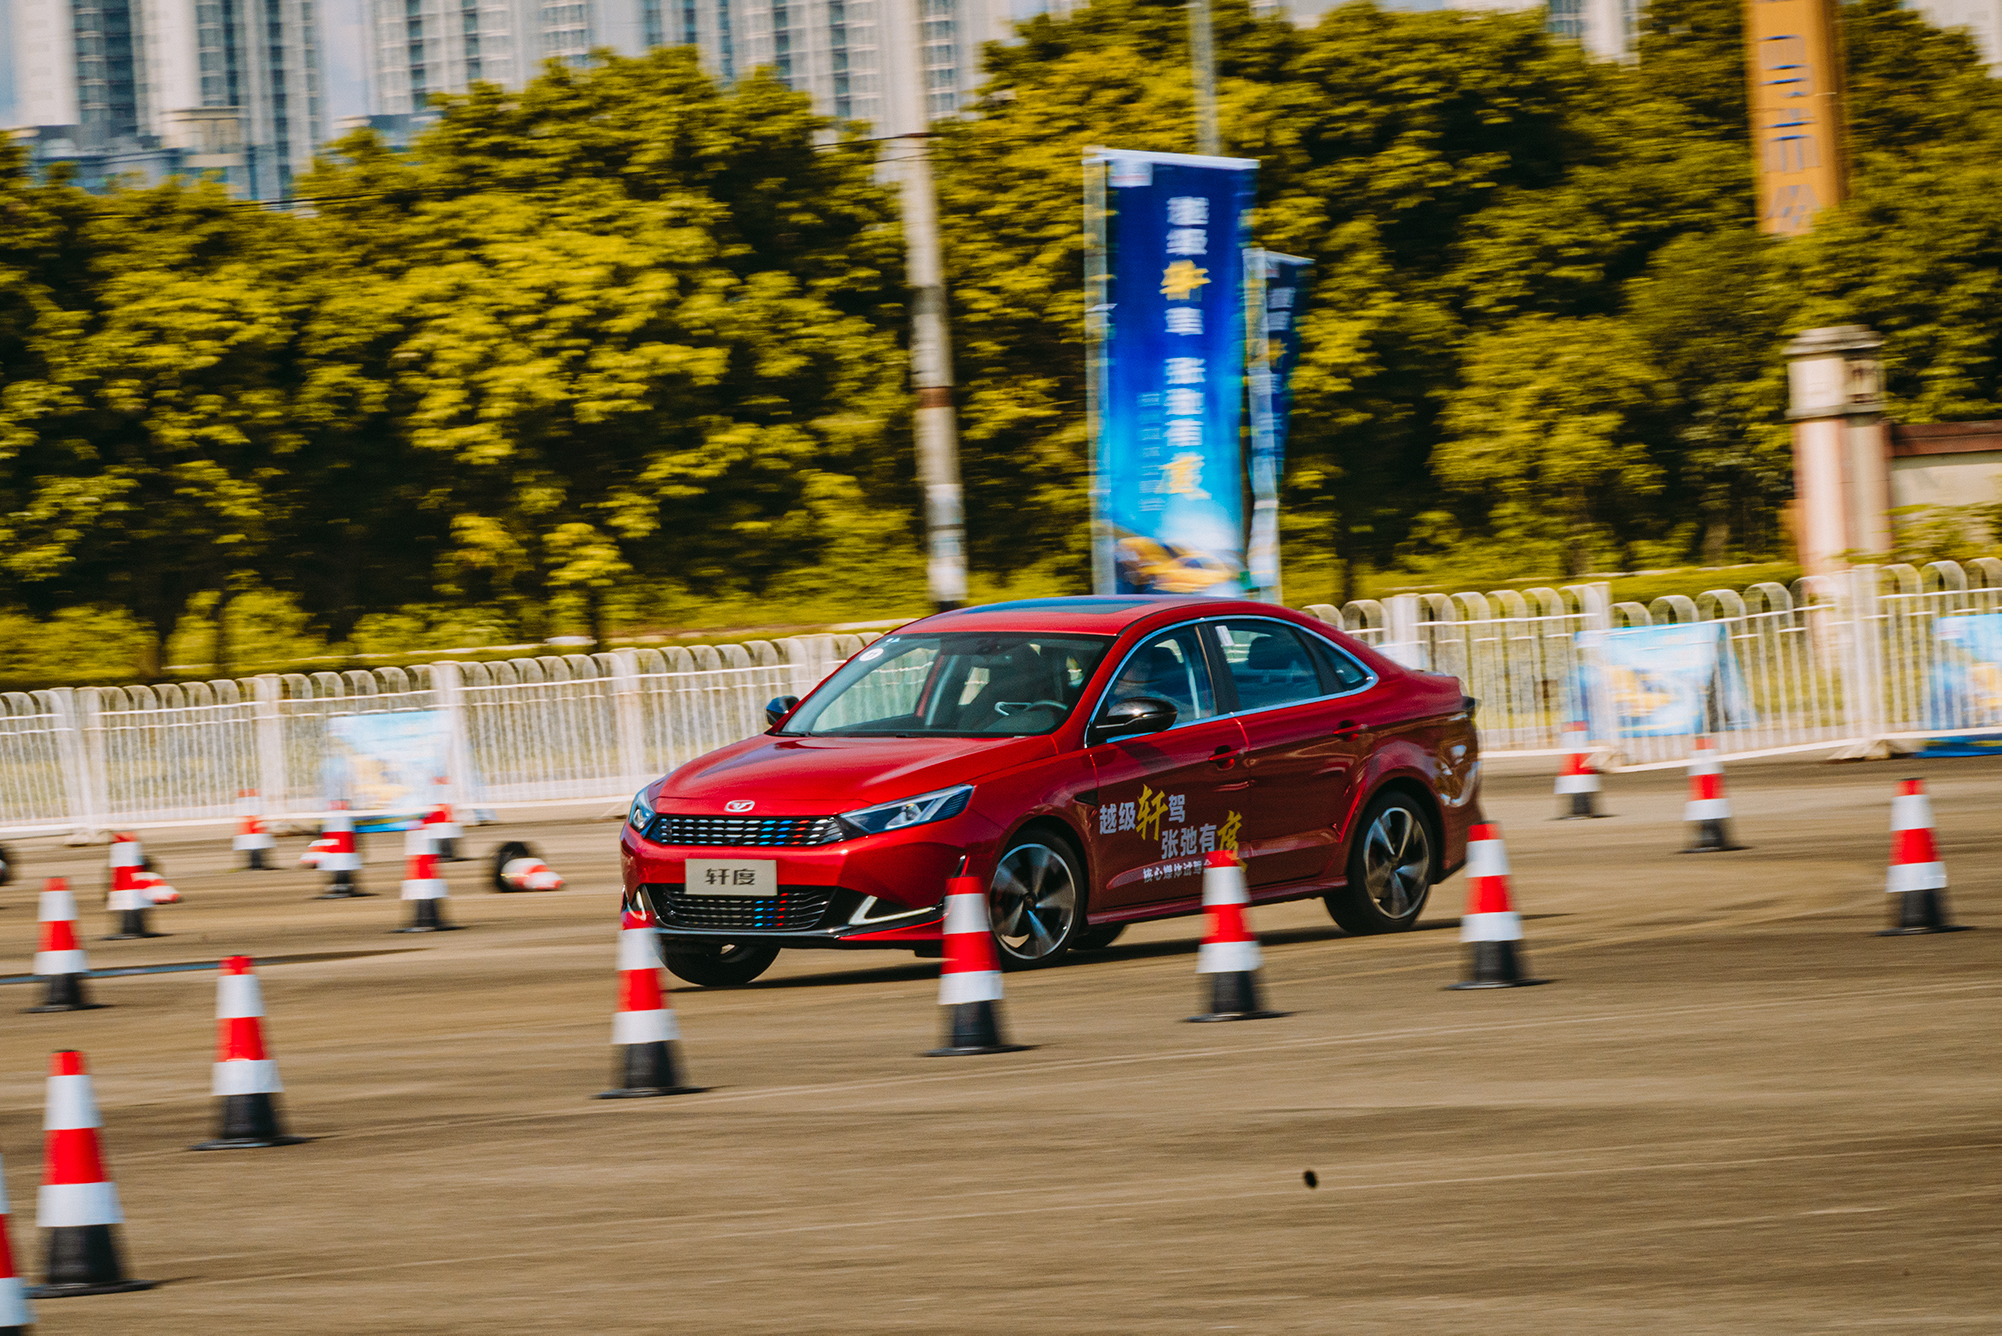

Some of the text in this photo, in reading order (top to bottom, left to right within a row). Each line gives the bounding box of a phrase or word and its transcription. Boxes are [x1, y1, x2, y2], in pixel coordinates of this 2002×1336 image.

[1099, 783, 1186, 841] 越级轩驾
[1161, 809, 1248, 873] 张弛有度
[704, 867, 756, 886] 轩度
